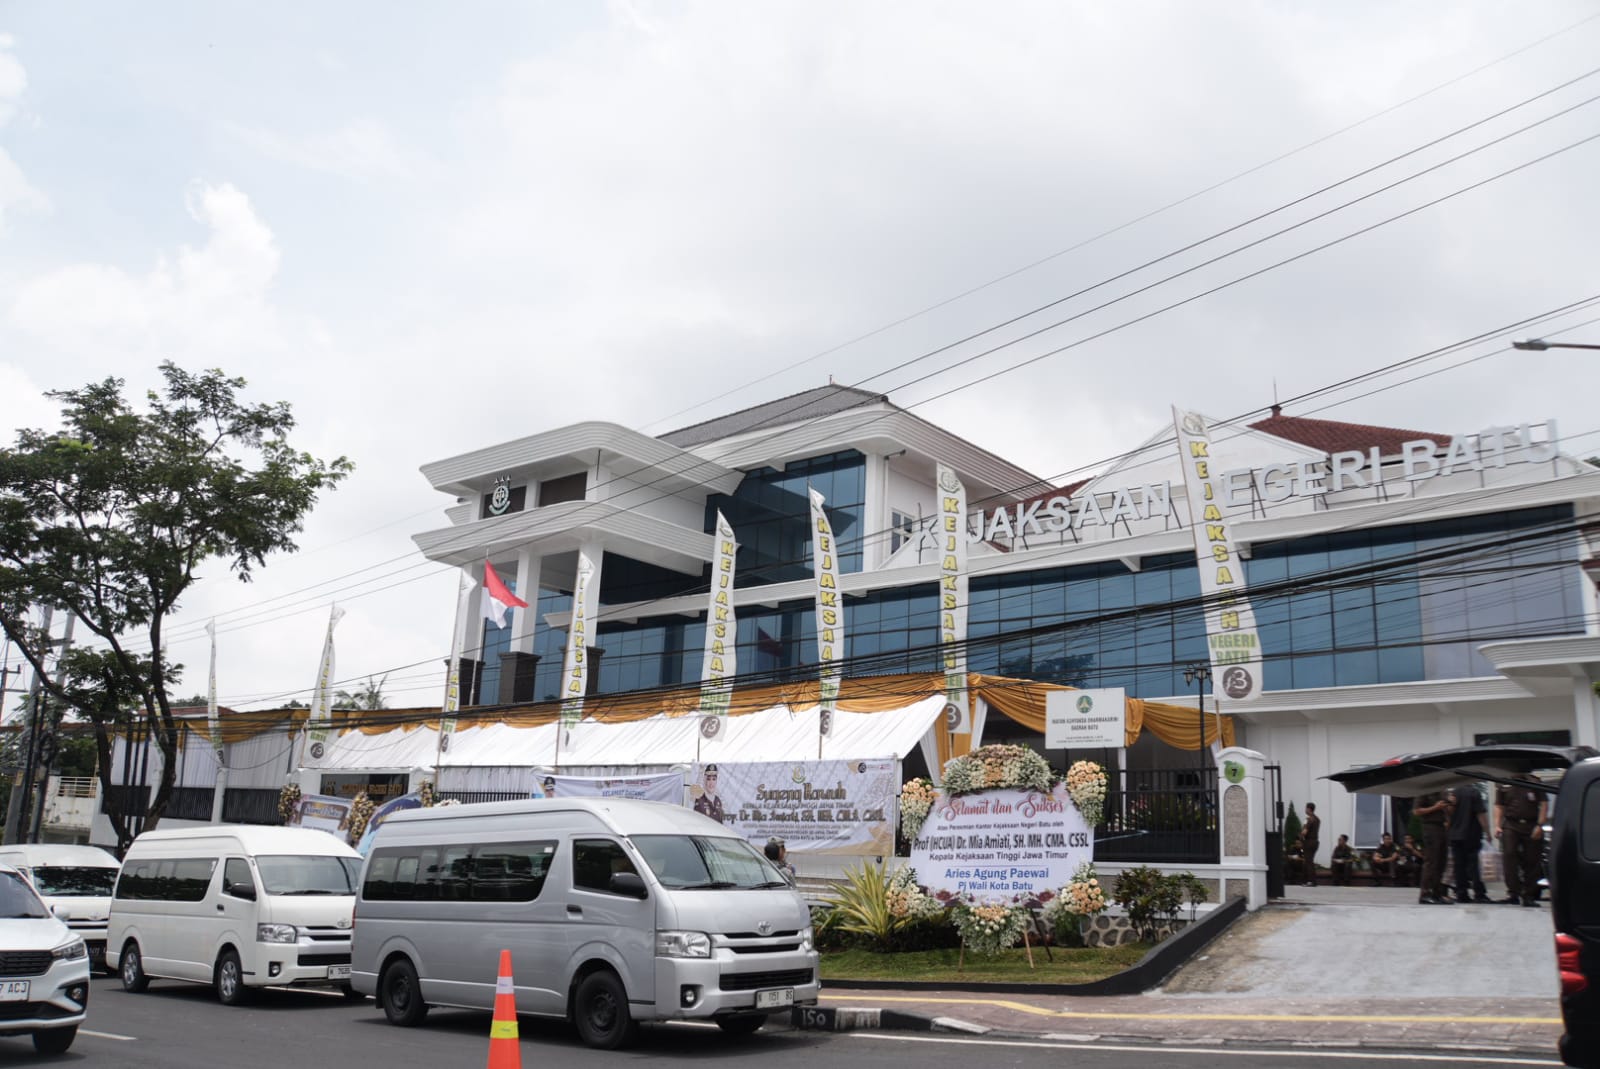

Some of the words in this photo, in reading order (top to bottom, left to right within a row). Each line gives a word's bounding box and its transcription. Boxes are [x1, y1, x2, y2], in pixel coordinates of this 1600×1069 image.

[914, 481, 1171, 549] KJAKSAAN
[1222, 446, 1381, 508] EGERI
[1402, 419, 1559, 481] BATU
[567, 578, 585, 706] JAKSAA
[938, 798, 990, 821] Selamat
[992, 800, 1012, 815] dan
[1016, 792, 1063, 818] Sukses
[913, 836, 929, 850] Prof
[930, 835, 955, 851] (HCUA)
[957, 836, 967, 849] Dr.
[969, 835, 982, 849] Mia
[1013, 834, 1026, 848] SH.
[1027, 834, 1043, 848] MH.
[1045, 833, 1067, 848] CMA.
[1069, 833, 1089, 847] CSSL
[929, 853, 954, 861] Kepala
[956, 852, 994, 861] Kejaksaan
[996, 851, 1020, 861] Tinggi
[1022, 851, 1043, 859] Jawa
[1045, 851, 1068, 859] Timur
[944, 868, 970, 878] Aries
[973, 868, 1007, 880] Agung
[1010, 867, 1049, 878] Paewai
[958, 882, 966, 892] Pj
[969, 881, 987, 890] Wali
[989, 881, 1009, 890] Kota
[1012, 881, 1033, 890] Batu
